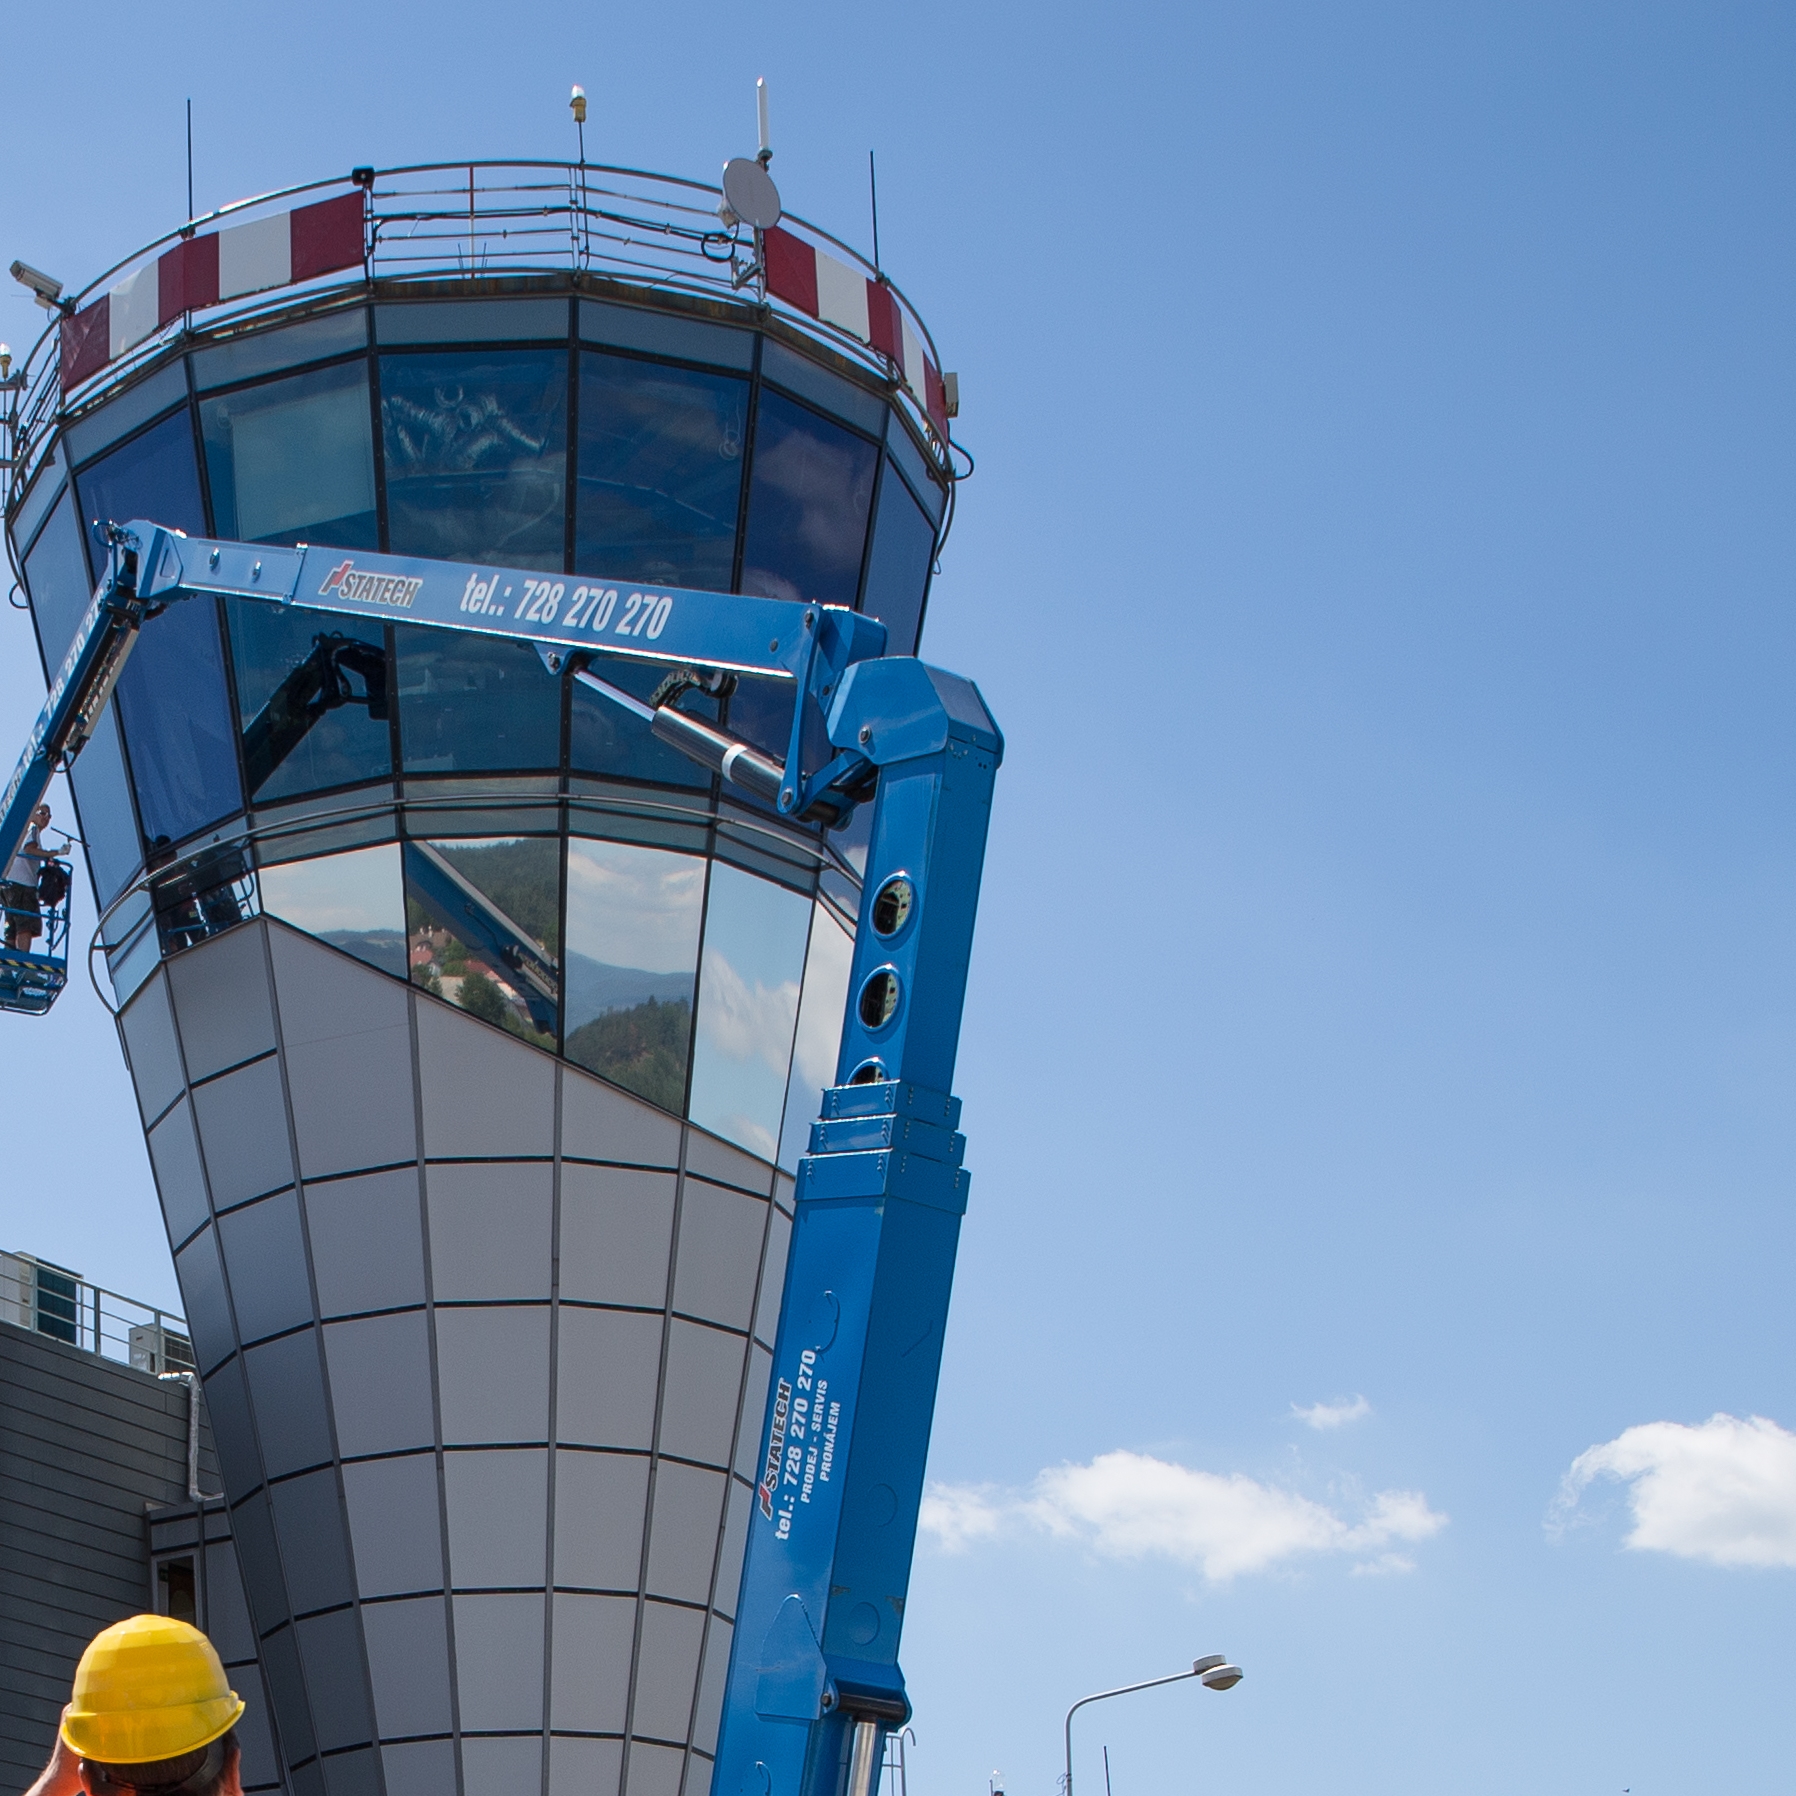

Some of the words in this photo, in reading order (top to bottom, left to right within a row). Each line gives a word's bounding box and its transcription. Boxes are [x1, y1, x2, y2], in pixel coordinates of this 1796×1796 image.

[339, 571, 423, 609] STATECH
[460, 572, 512, 617] tel.:
[514, 579, 563, 624] 728
[562, 586, 615, 632] 270
[615, 594, 673, 641] 270
[44, 677, 65, 719] 728
[65, 635, 86, 678] 270
[797, 1349, 816, 1391] 270
[765, 1378, 792, 1491] STATECH
[790, 1398, 808, 1440] 270
[800, 1447, 818, 1504] PRODEJ
[811, 1379, 828, 1432] SERVIS
[820, 1402, 841, 1482] PRONÁJEM
[783, 1446, 802, 1486] 728
[775, 1494, 795, 1541] tel.:
